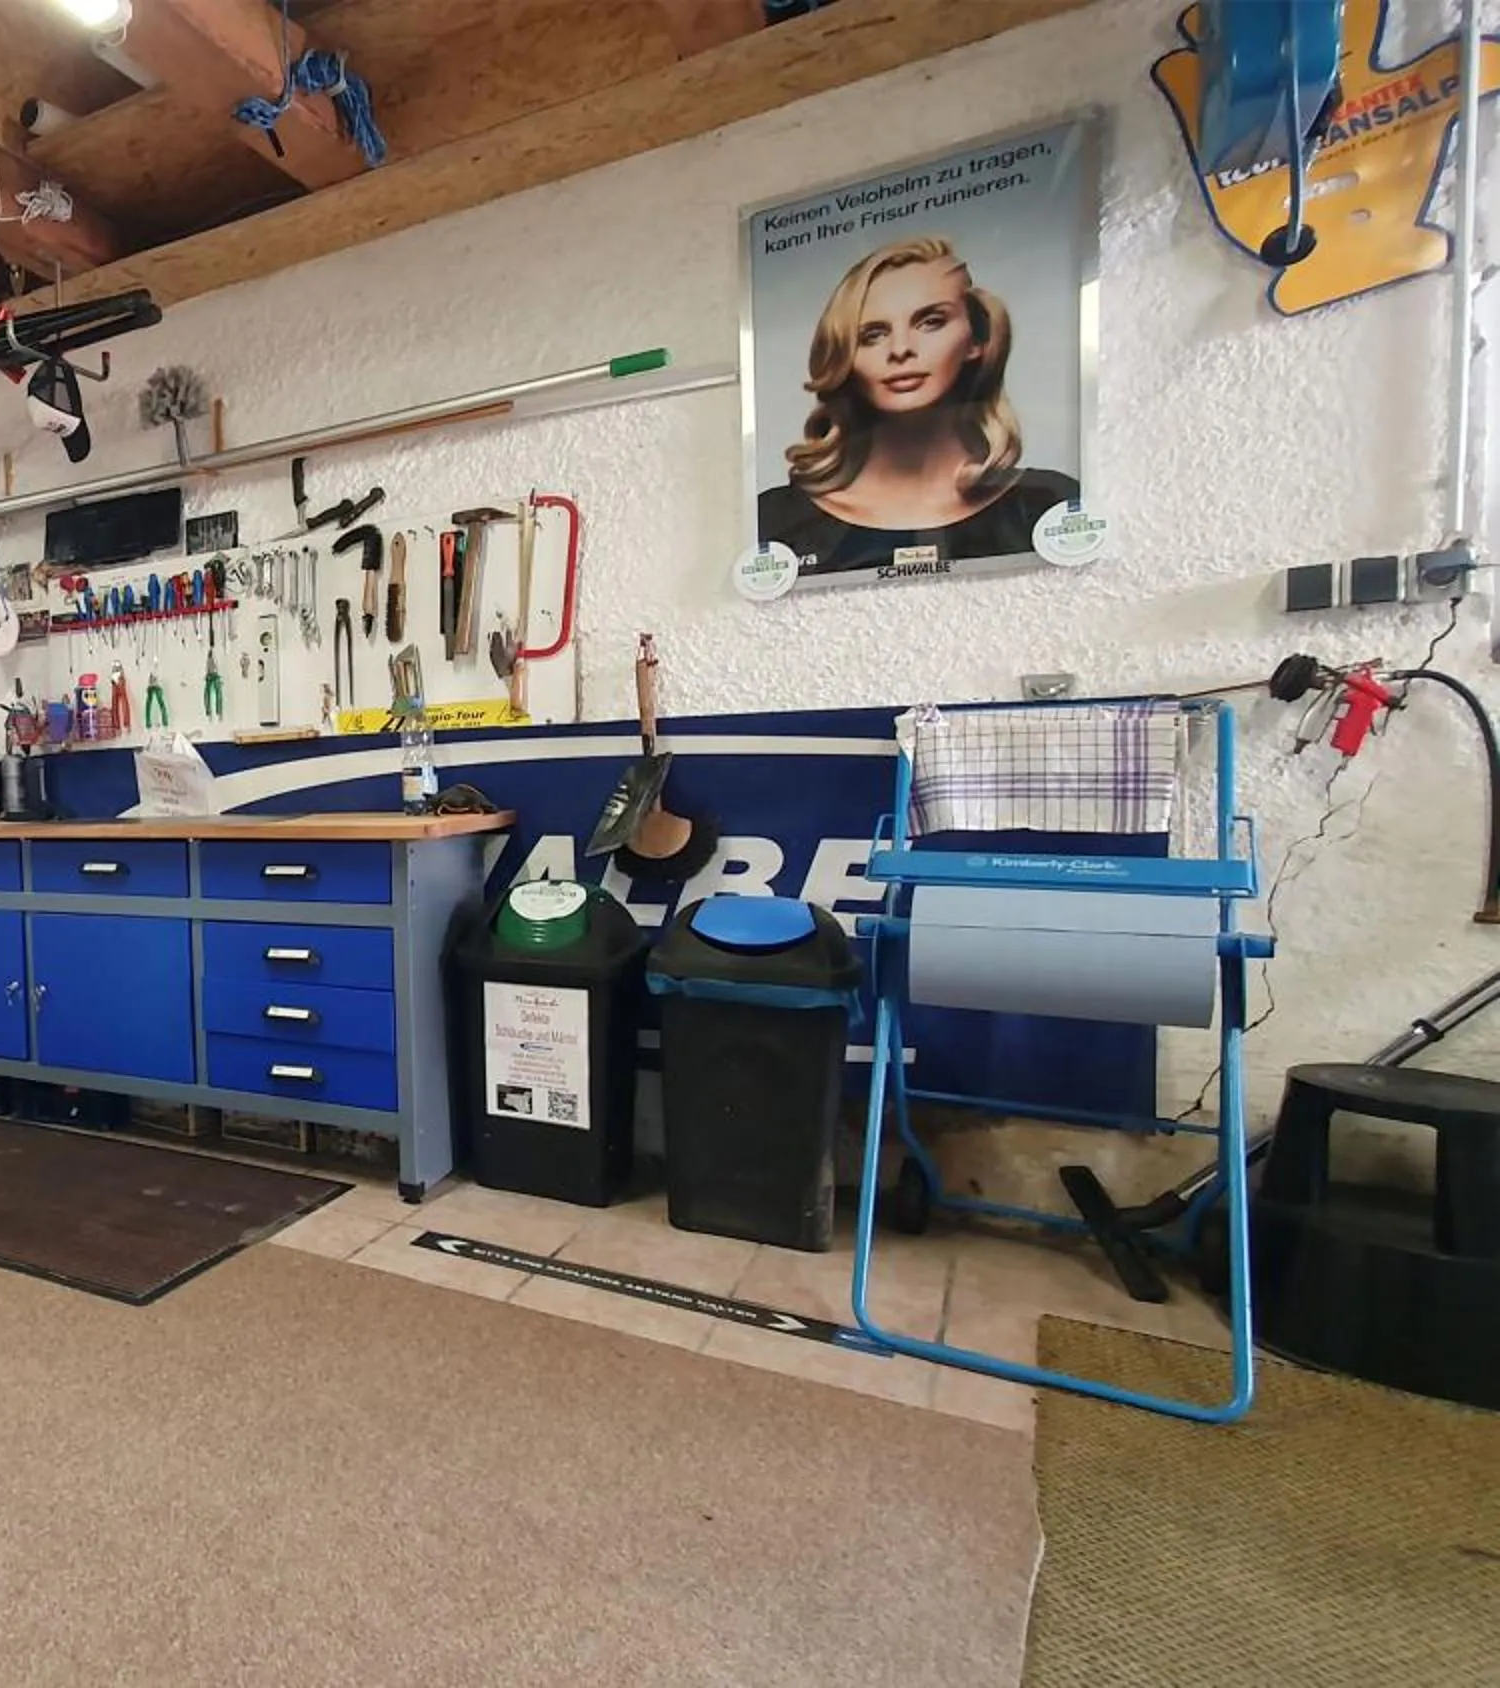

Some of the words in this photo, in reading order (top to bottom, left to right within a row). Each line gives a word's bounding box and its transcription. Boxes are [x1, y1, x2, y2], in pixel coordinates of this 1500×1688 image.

[765, 203, 831, 232] Keinen
[835, 175, 931, 212] Velohelm
[937, 165, 963, 184] zu
[969, 141, 1052, 174] tragen,
[765, 231, 811, 254] kann
[817, 219, 855, 240] Ihre
[860, 200, 919, 229] Frisur
[925, 170, 1031, 211] ruinieren.
[877, 561, 951, 579] SCHWALBE
